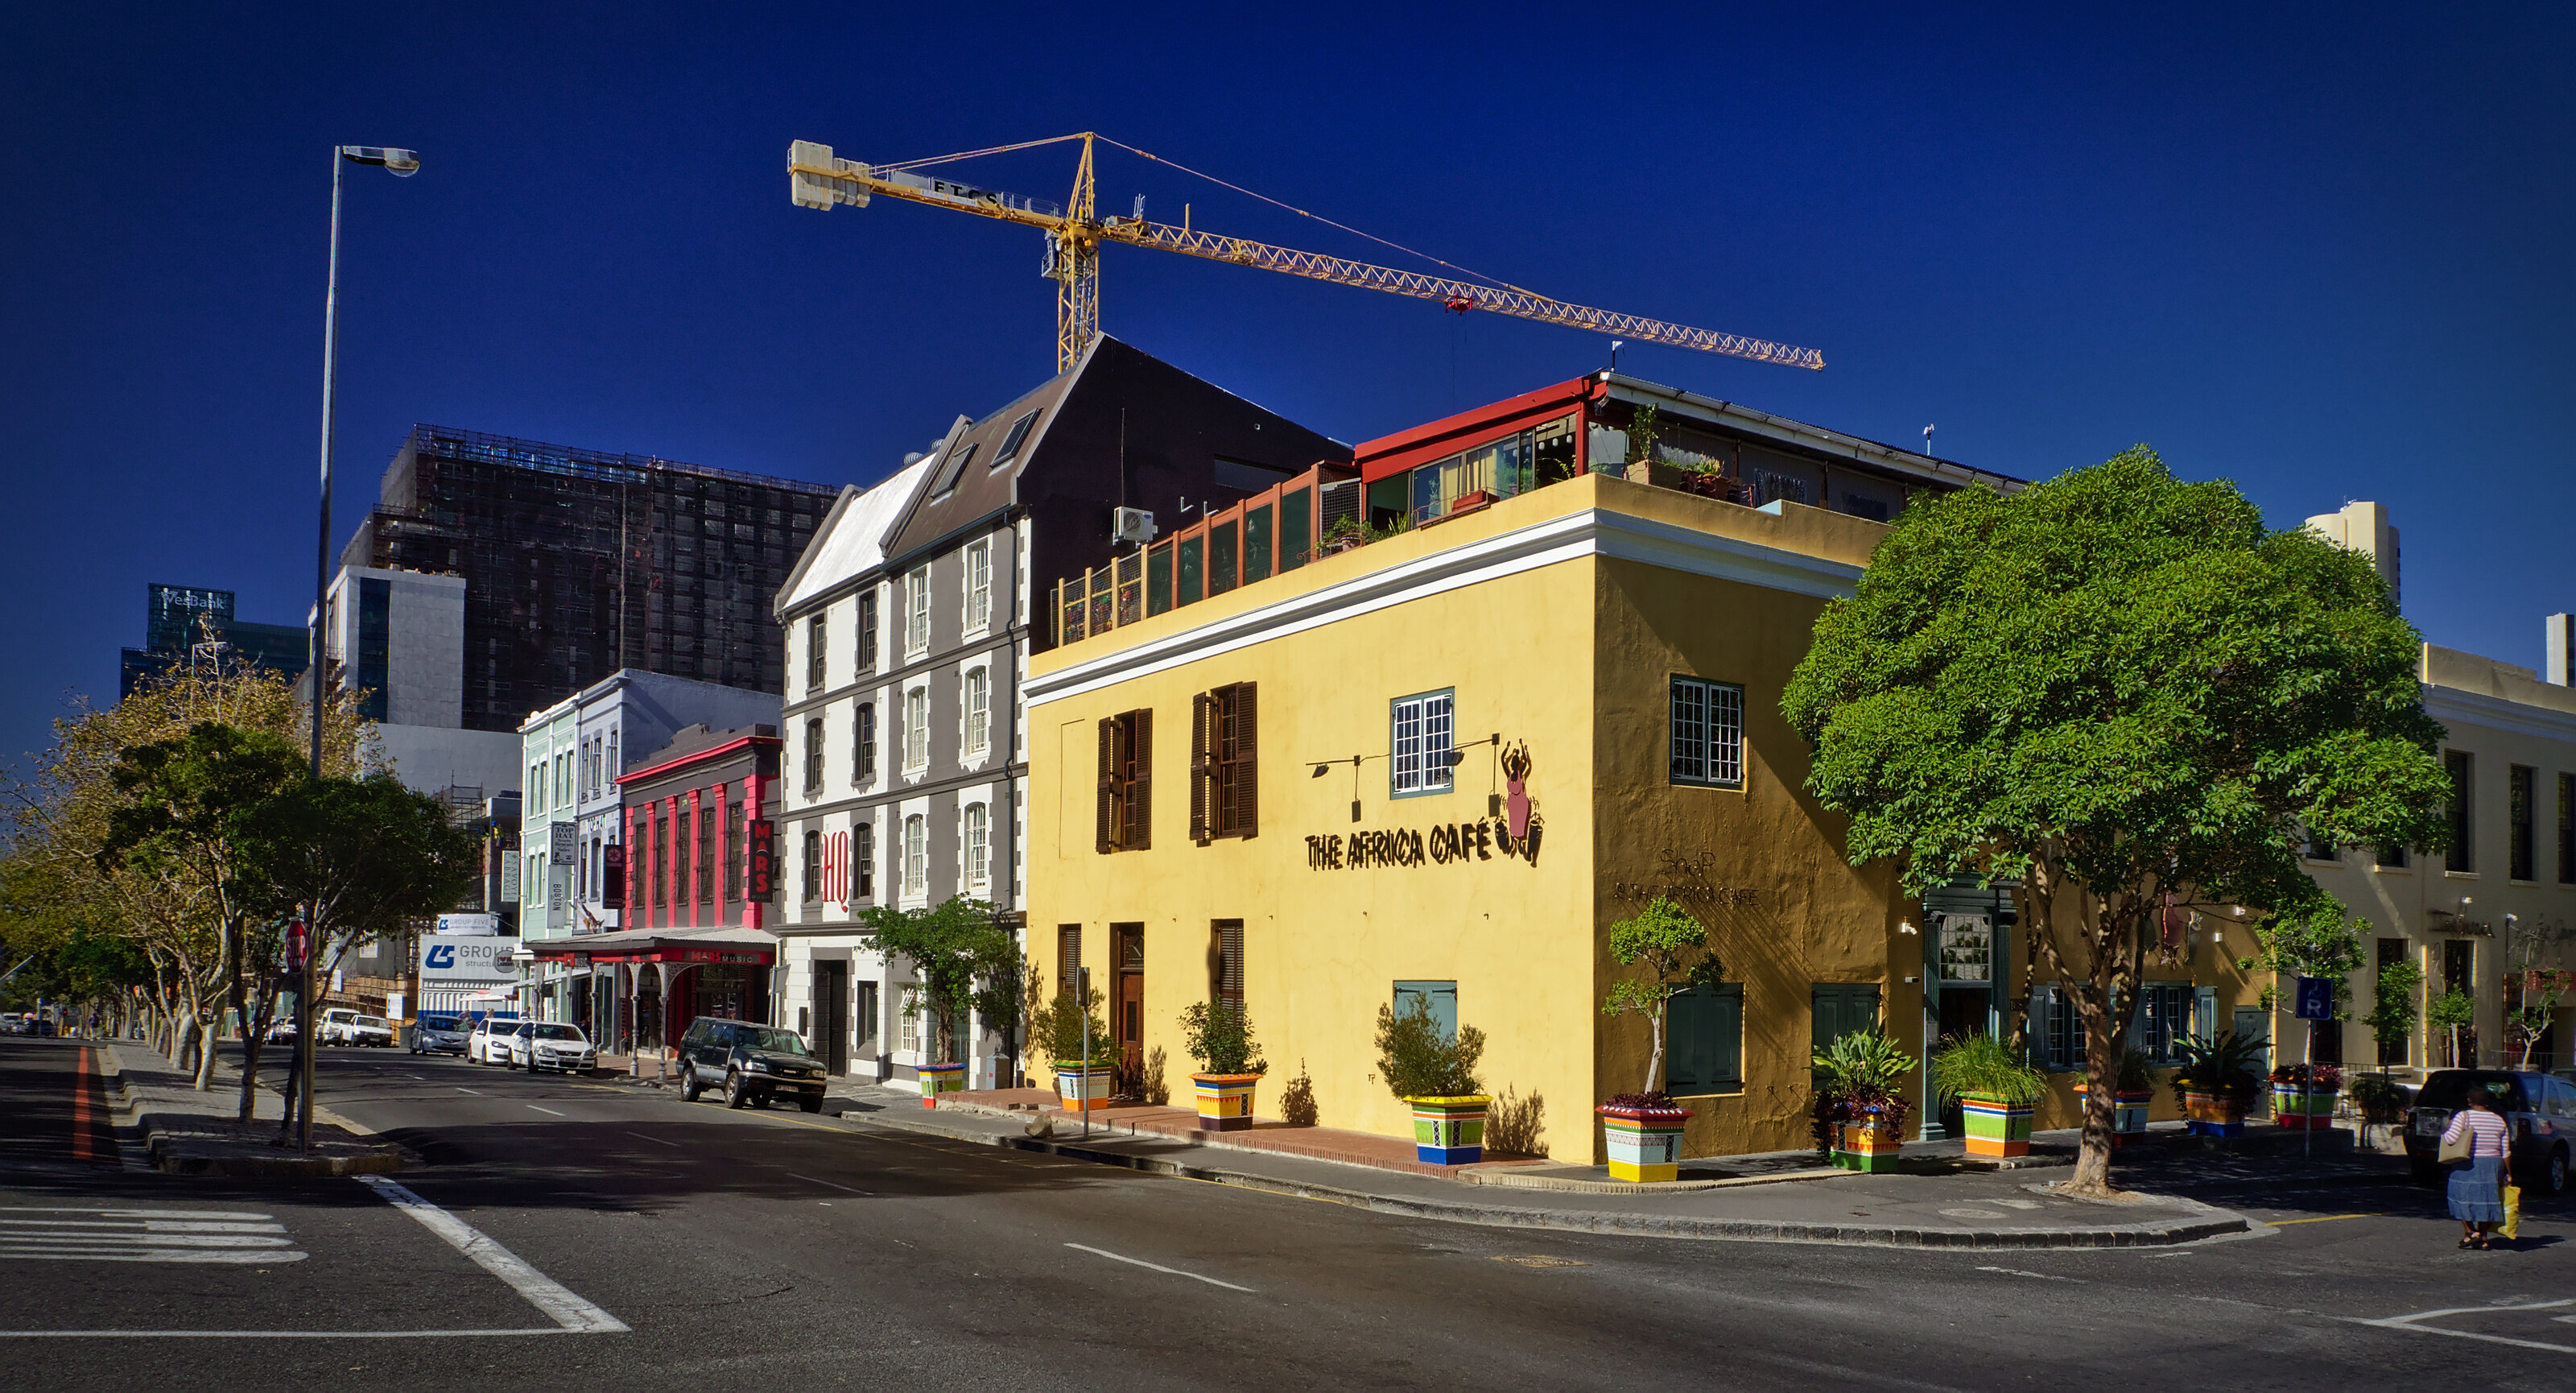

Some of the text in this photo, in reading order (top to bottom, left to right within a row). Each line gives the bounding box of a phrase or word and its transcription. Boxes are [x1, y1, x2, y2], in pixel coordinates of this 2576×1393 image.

[1304, 816, 1491, 871] THE AFRICA CAFÉ
[754, 823, 770, 893] MARS
[552, 883, 562, 911] BOSTON
[1665, 885, 1715, 903] AFRICA
[287, 935, 306, 958] STOP
[691, 951, 721, 962] MARS
[2306, 998, 2322, 1016] R
